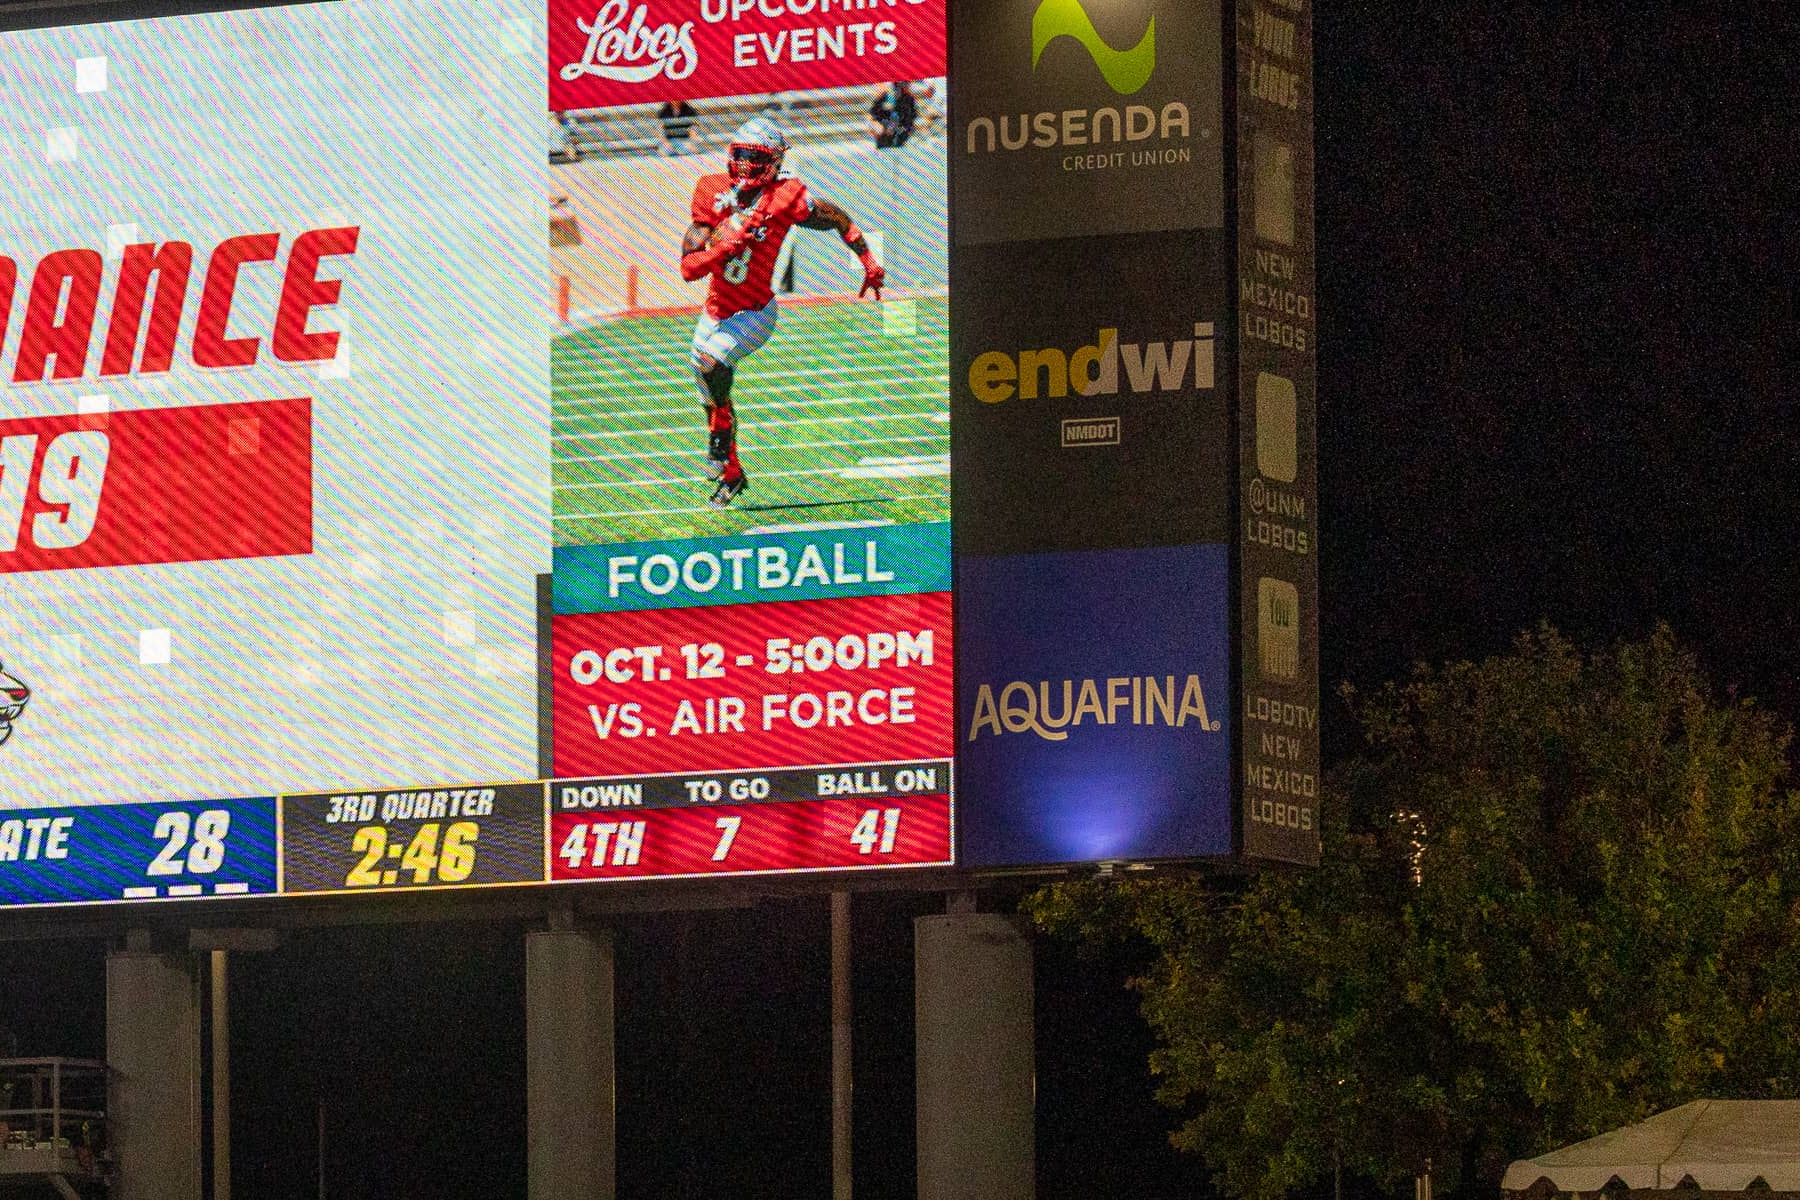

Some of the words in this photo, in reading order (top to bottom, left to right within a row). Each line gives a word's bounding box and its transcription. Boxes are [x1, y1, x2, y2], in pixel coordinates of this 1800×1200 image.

[733, 21, 898, 67] EVENTS
[1063, 152, 1123, 171] CREDIT
[1132, 148, 1190, 167] UNION
[1256, 249, 1295, 280] NEW
[1241, 279, 1308, 319] MEXICO
[1245, 312, 1306, 352] LOBOS
[969, 322, 1215, 404] endwi
[1066, 424, 1116, 441] NMDOT
[1247, 519, 1308, 555] LOBOS
[608, 541, 895, 598] FOOTBALL
[569, 645, 672, 685] OCT.
[680, 642, 726, 679] 12
[765, 629, 934, 675] 5:00PM
[587, 703, 657, 740] VS.
[669, 697, 746, 736] AIR
[762, 686, 916, 731] FORCE
[968, 674, 1211, 741] AQUAFINA
[1247, 694, 1316, 730] LOBOTV
[1262, 732, 1300, 760] NEW
[561, 784, 643, 809] DOWN
[684, 780, 721, 803] TO
[729, 777, 770, 799] GO
[816, 772, 888, 796] BALL
[895, 768, 937, 792] ON
[1247, 763, 1314, 797] MEXICO
[326, 794, 375, 824] 3RD
[382, 789, 495, 825] QUARTER
[1251, 798, 1311, 831] LOBOS
[146, 810, 231, 876] 28
[559, 821, 647, 868] 4TH
[712, 815, 742, 862] 7
[849, 807, 901, 854] 41
[345, 822, 478, 888] 2:46
